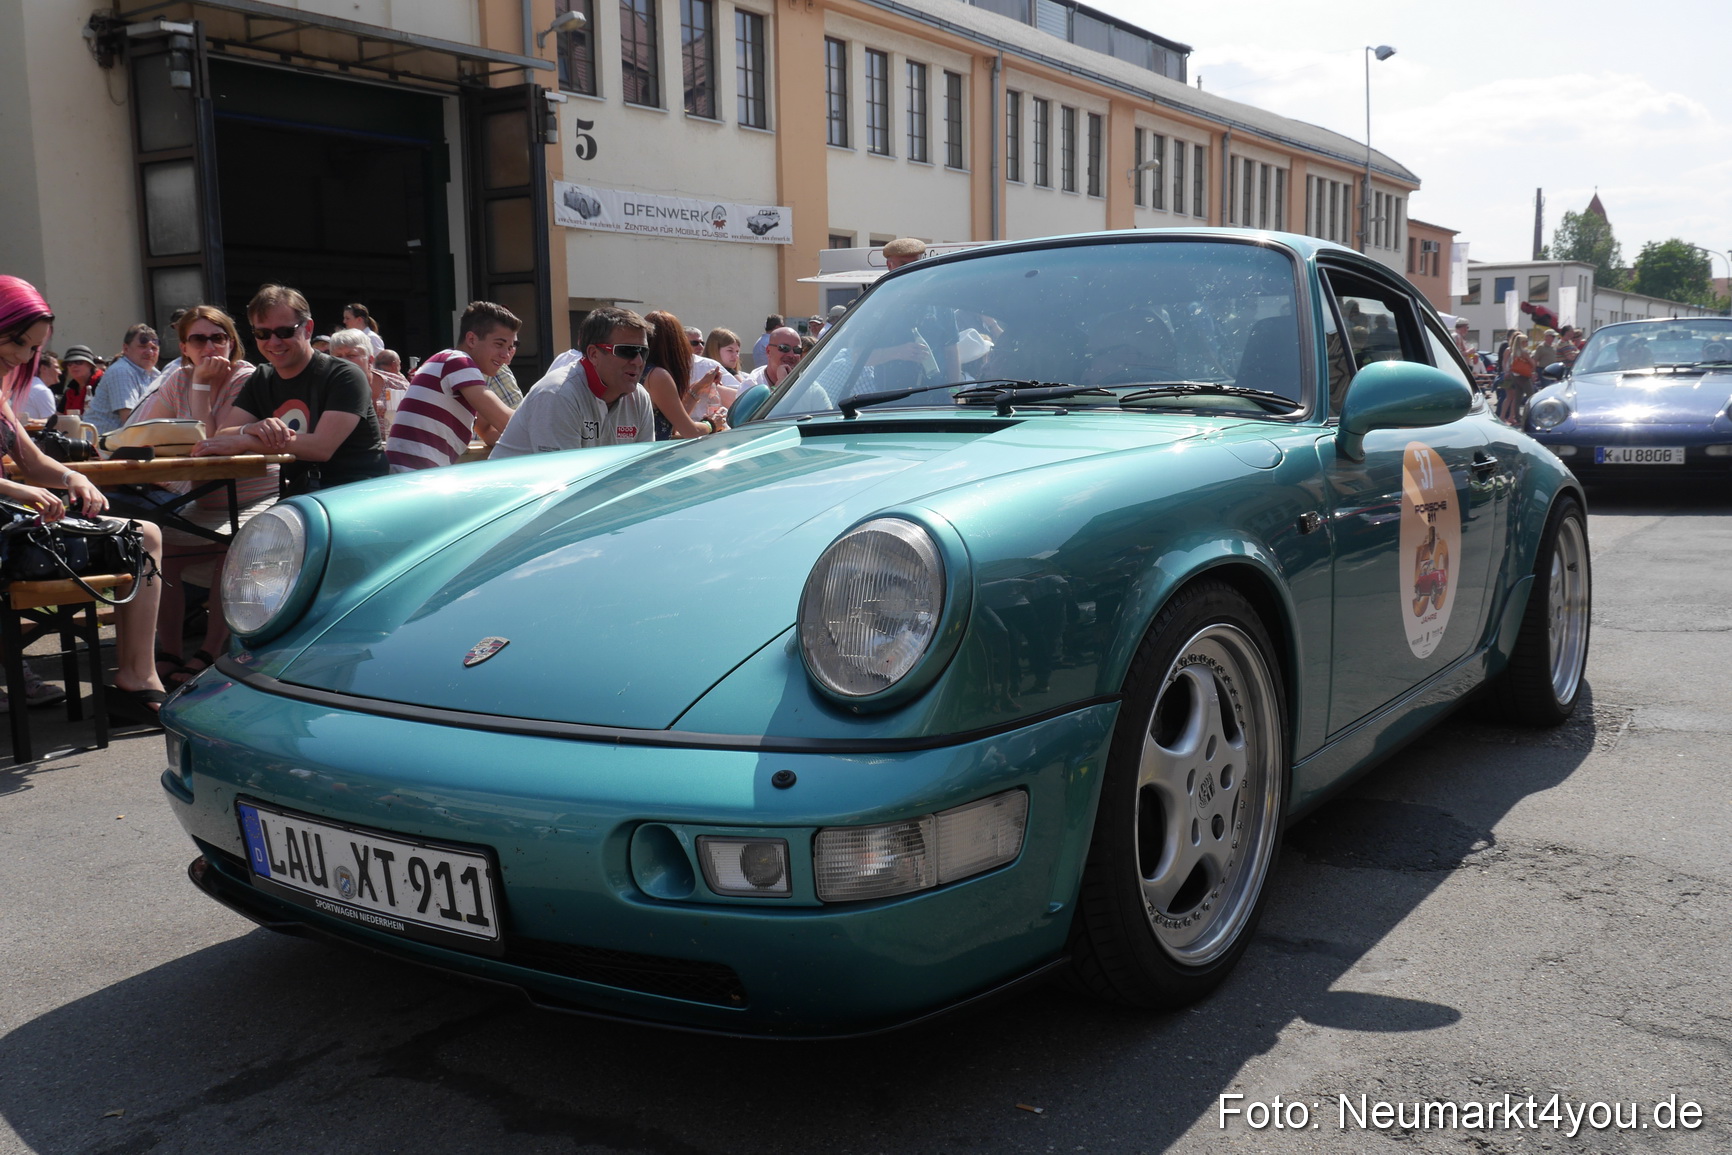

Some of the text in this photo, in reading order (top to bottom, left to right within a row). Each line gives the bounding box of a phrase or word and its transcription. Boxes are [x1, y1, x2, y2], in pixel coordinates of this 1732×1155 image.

[575, 117, 598, 161] 5
[623, 202, 710, 224] OFENWERK
[1413, 449, 1434, 490] 37
[1604, 449, 1614, 462] K
[1622, 449, 1633, 462] U
[1414, 500, 1448, 514] PORSCHE
[1427, 511, 1437, 523] 911
[261, 819, 490, 927] LAU XT 911
[315, 898, 405, 932] SPORTWAGEN NIEDERRHEIN
